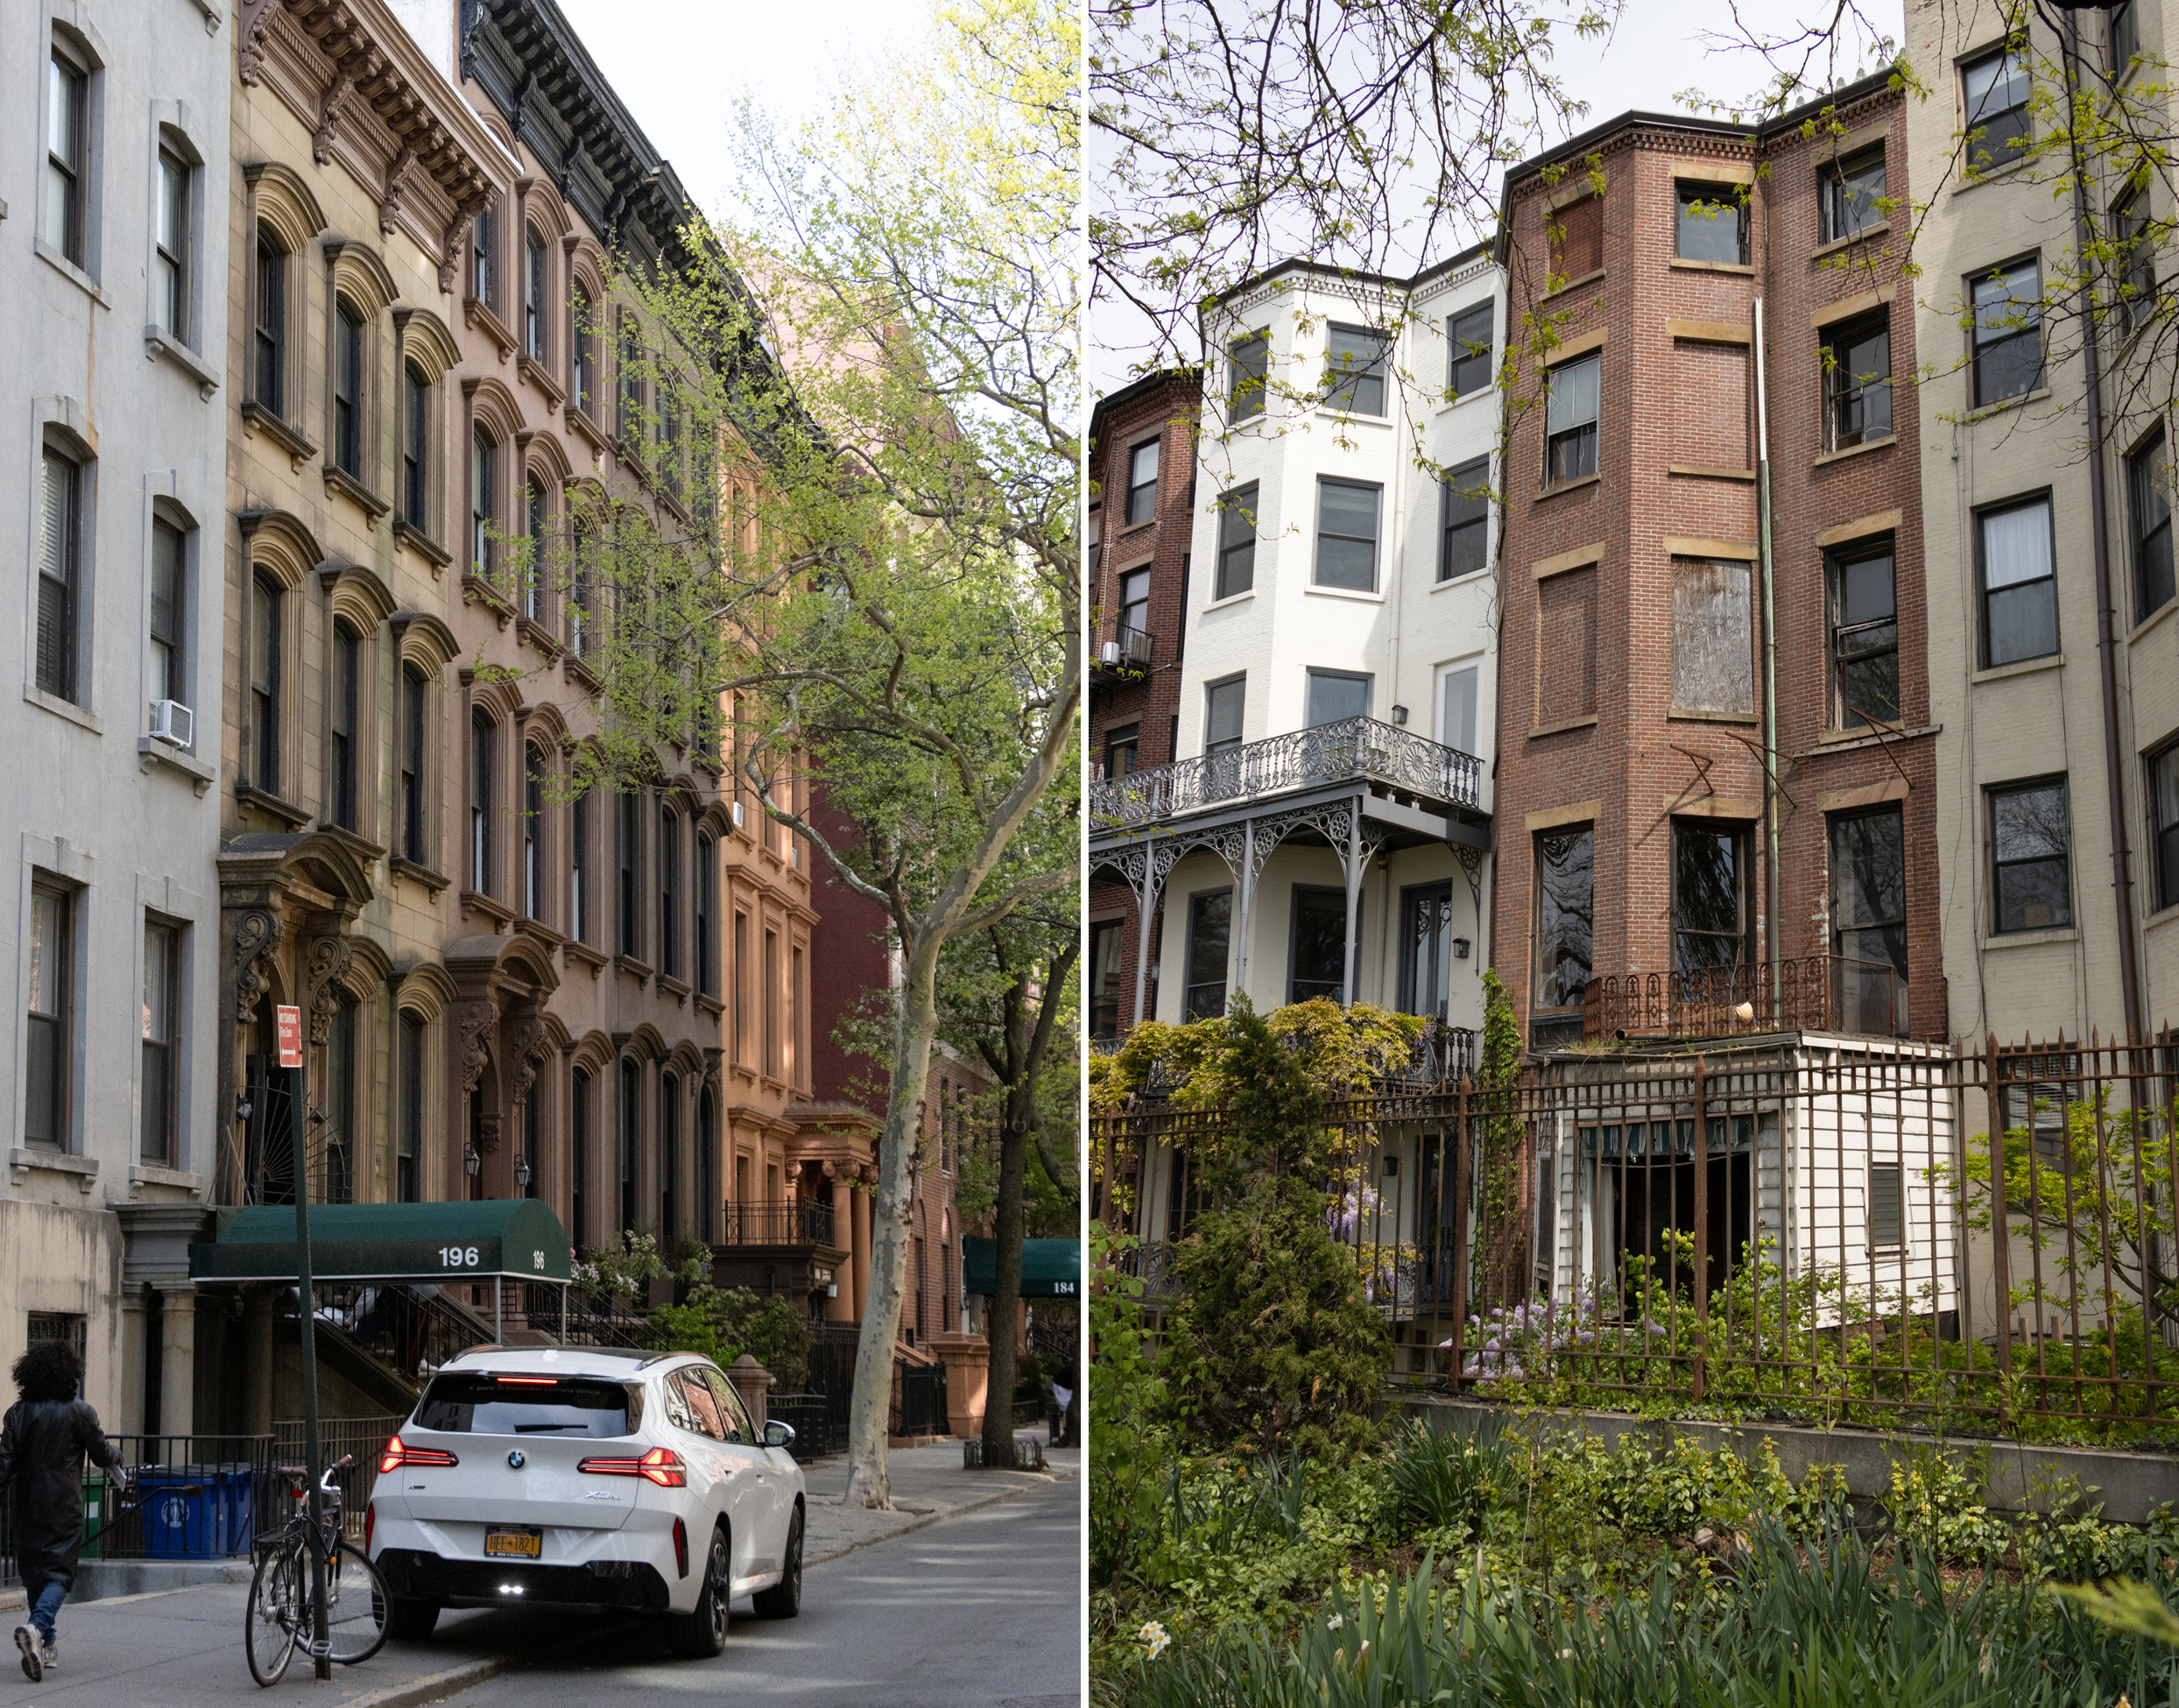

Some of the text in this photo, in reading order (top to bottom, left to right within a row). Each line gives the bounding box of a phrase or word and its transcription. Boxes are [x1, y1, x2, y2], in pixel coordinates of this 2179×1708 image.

[284, 1013, 296, 1024] STANDING
[439, 1246, 479, 1267] 196
[533, 1250, 545, 1269] 196
[1054, 1281, 1075, 1294] 184
[584, 1491, 610, 1500] X3
